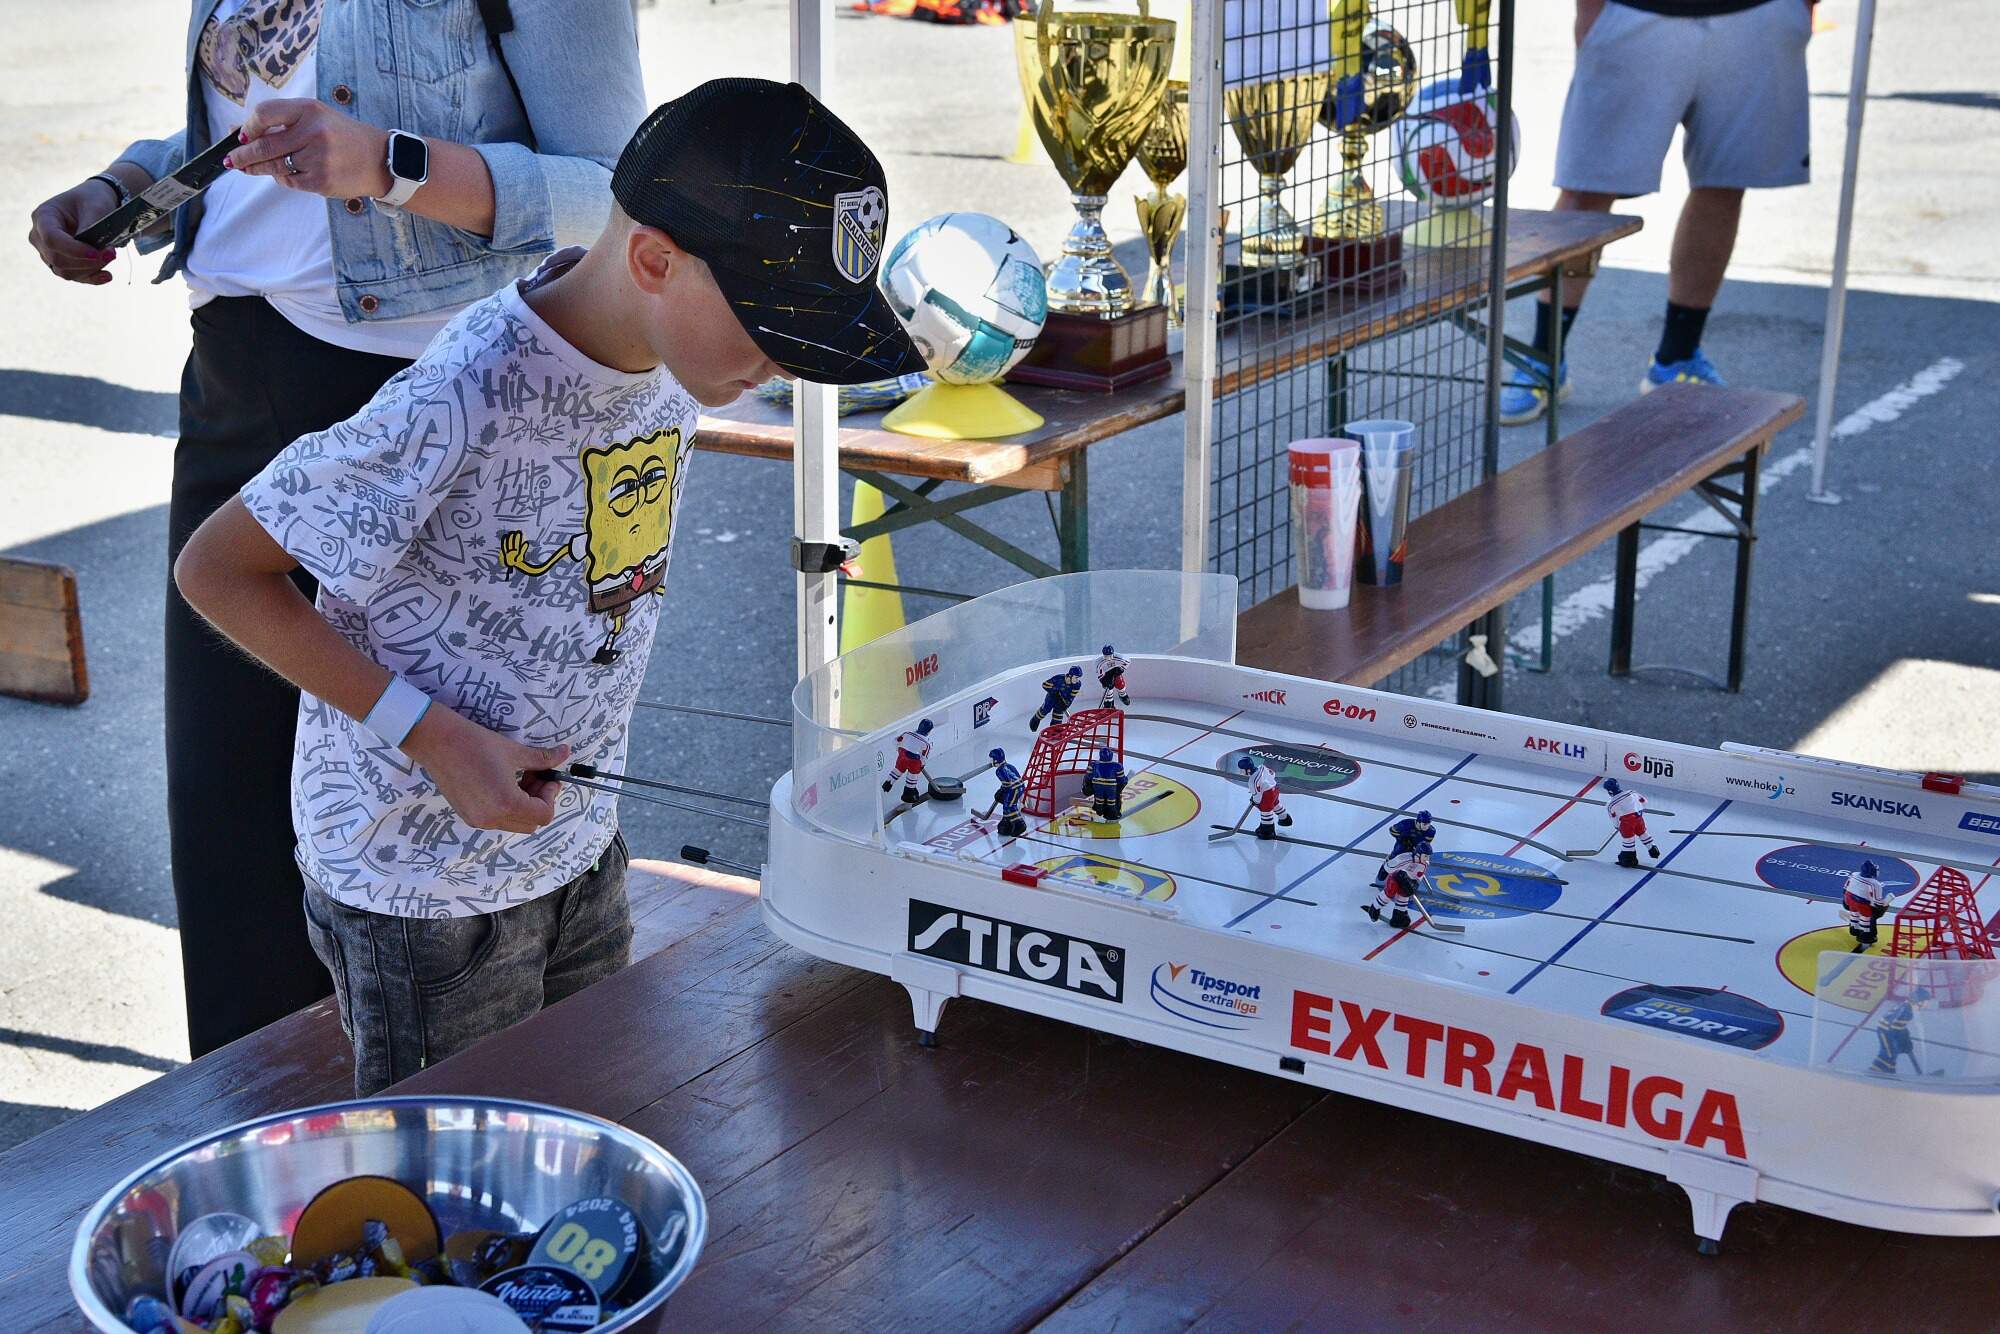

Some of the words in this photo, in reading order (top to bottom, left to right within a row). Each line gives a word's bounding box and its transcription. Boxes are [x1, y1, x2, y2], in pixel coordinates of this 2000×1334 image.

[841, 212, 877, 260] KRALOVICE
[479, 368, 539, 413] HIP
[1524, 736, 1560, 755] APK
[1564, 742, 1587, 760] LH
[1643, 755, 1674, 779] bpa
[1726, 776, 1796, 800] www.hokej.cz
[1831, 791, 1922, 819] SKANSKA
[398, 803, 461, 851] HIP
[914, 912, 1117, 997] STIGA
[1190, 969, 1260, 999] Tipsport
[1201, 993, 1257, 1014] extraliga
[1623, 1006, 1749, 1037] SPORT
[1290, 989, 1747, 1159] EXTRALIGA
[495, 1281, 573, 1303] Winter
